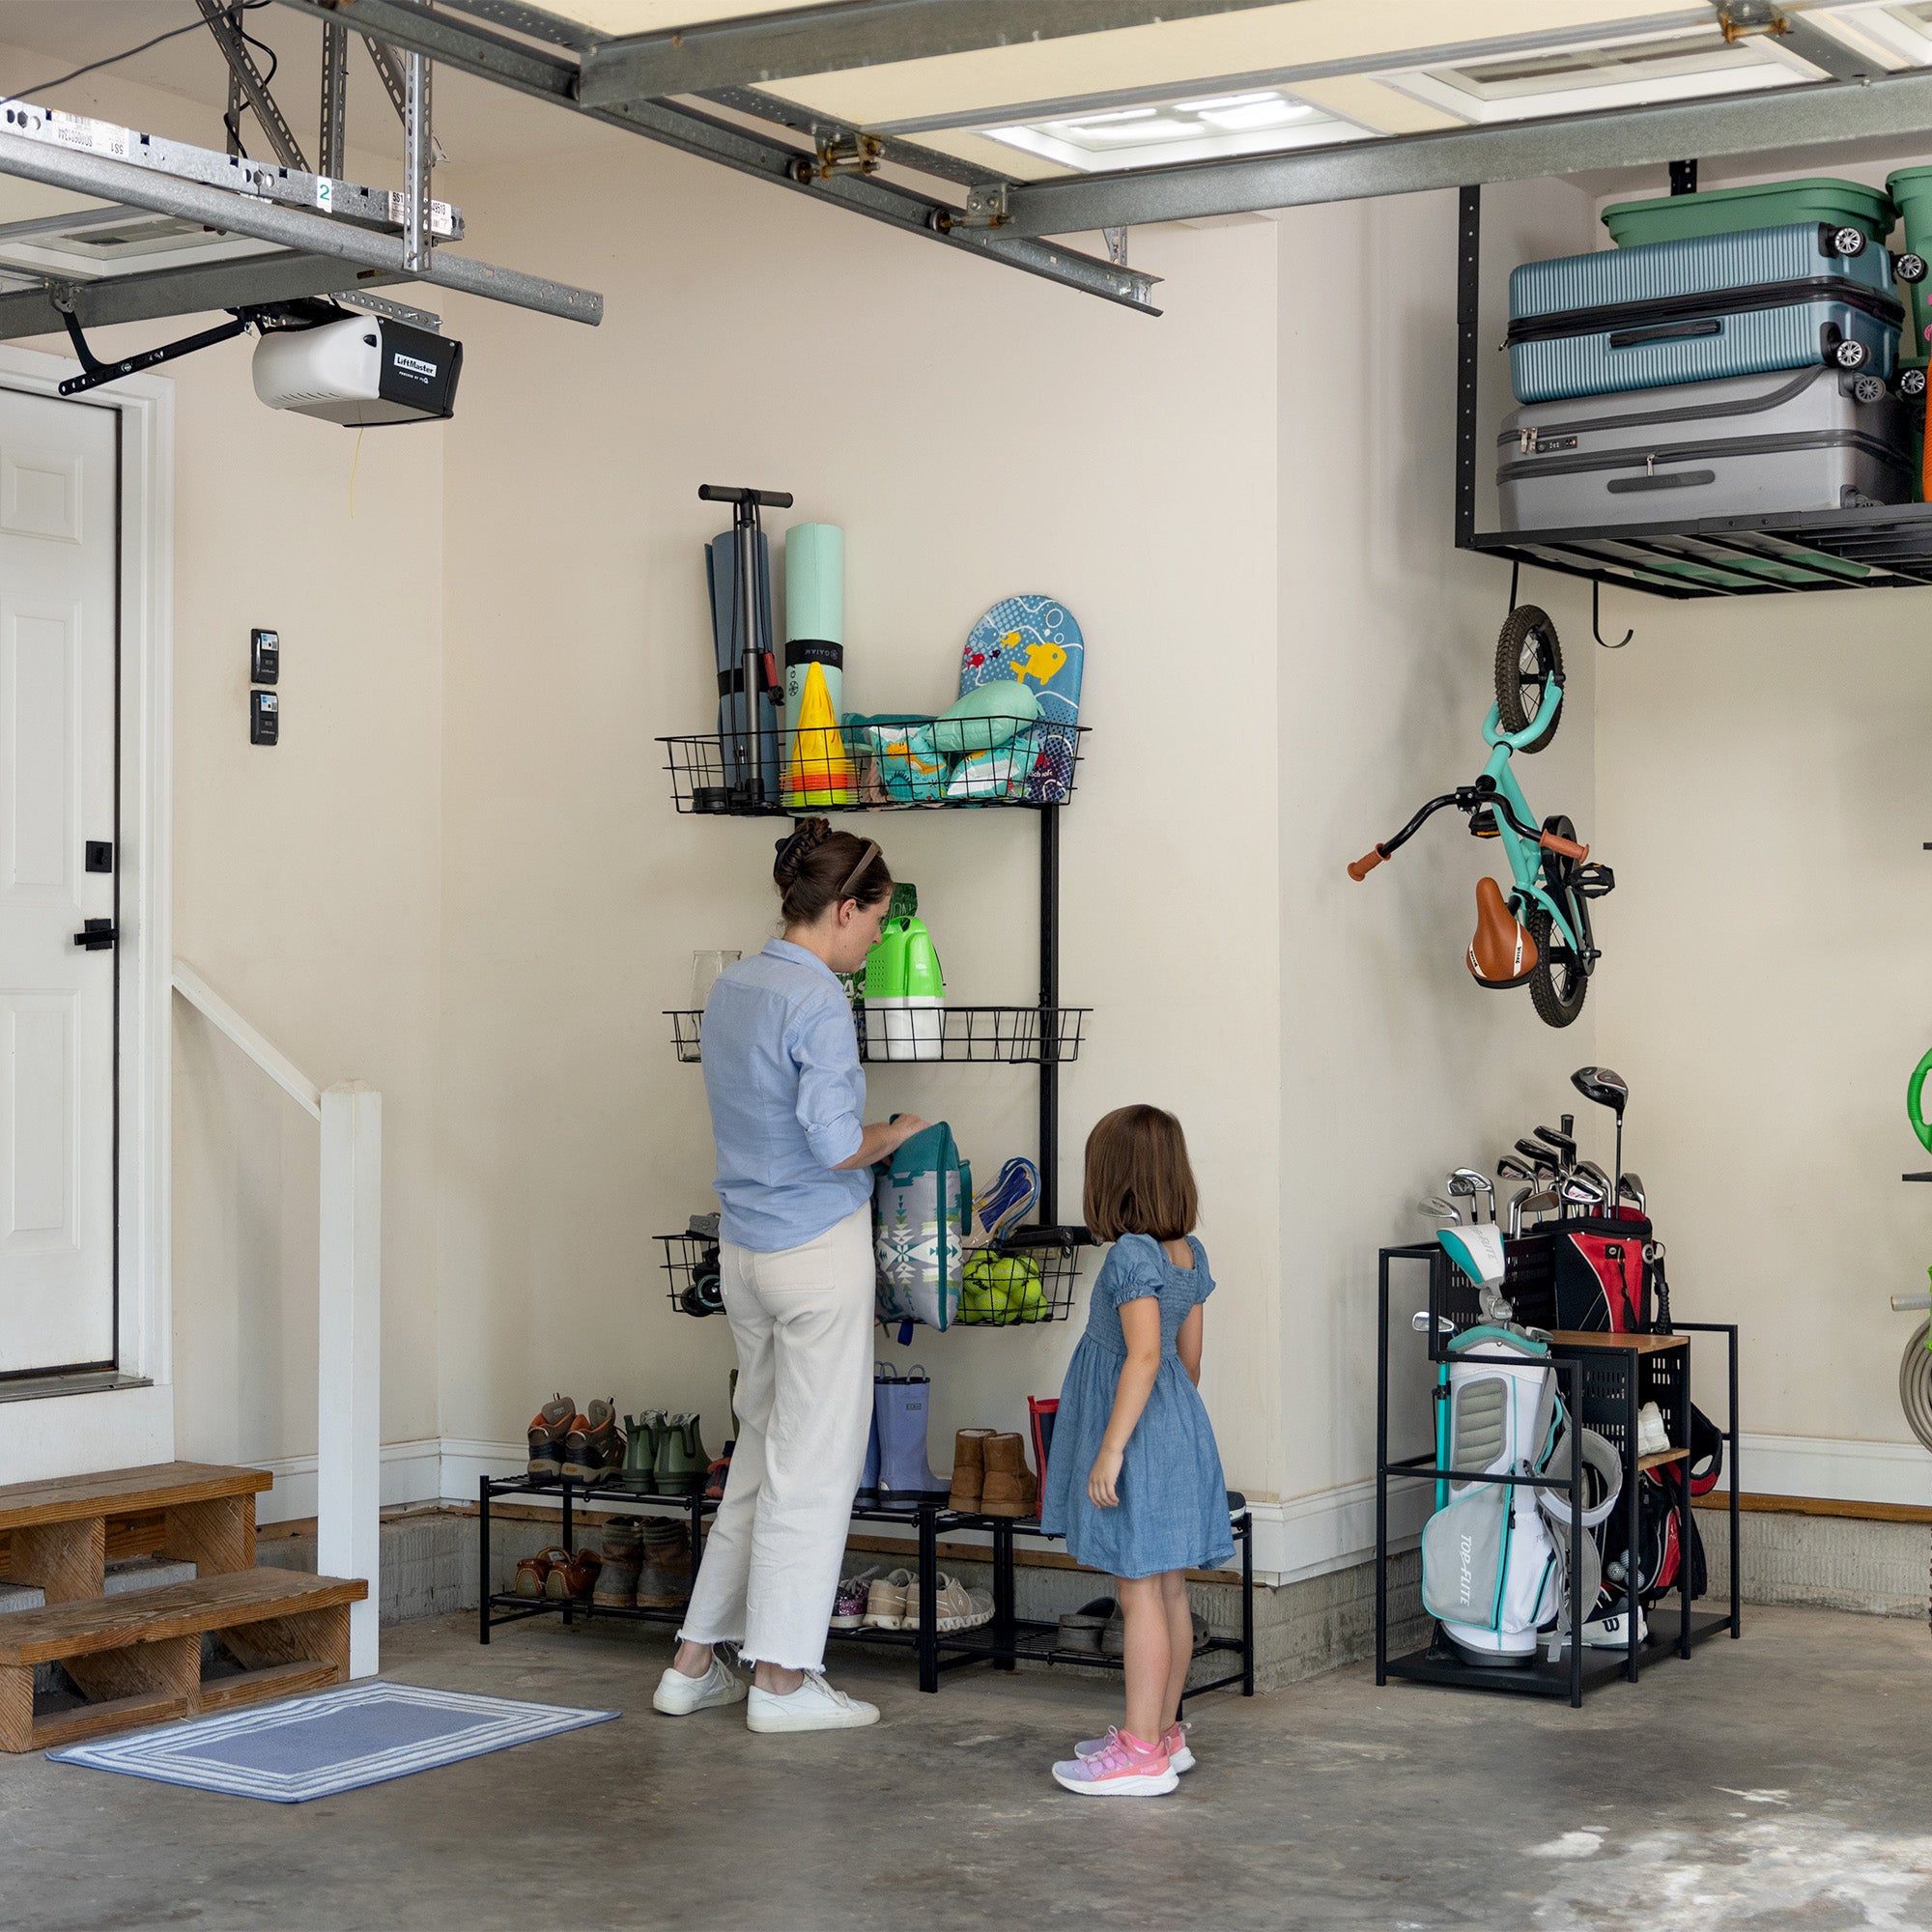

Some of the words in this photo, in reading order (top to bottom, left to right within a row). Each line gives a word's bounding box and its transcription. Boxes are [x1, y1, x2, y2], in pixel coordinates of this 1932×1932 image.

[319, 184, 330, 201] 2
[396, 355, 434, 374] LiftMaster
[805, 648, 830, 657] GAIAM
